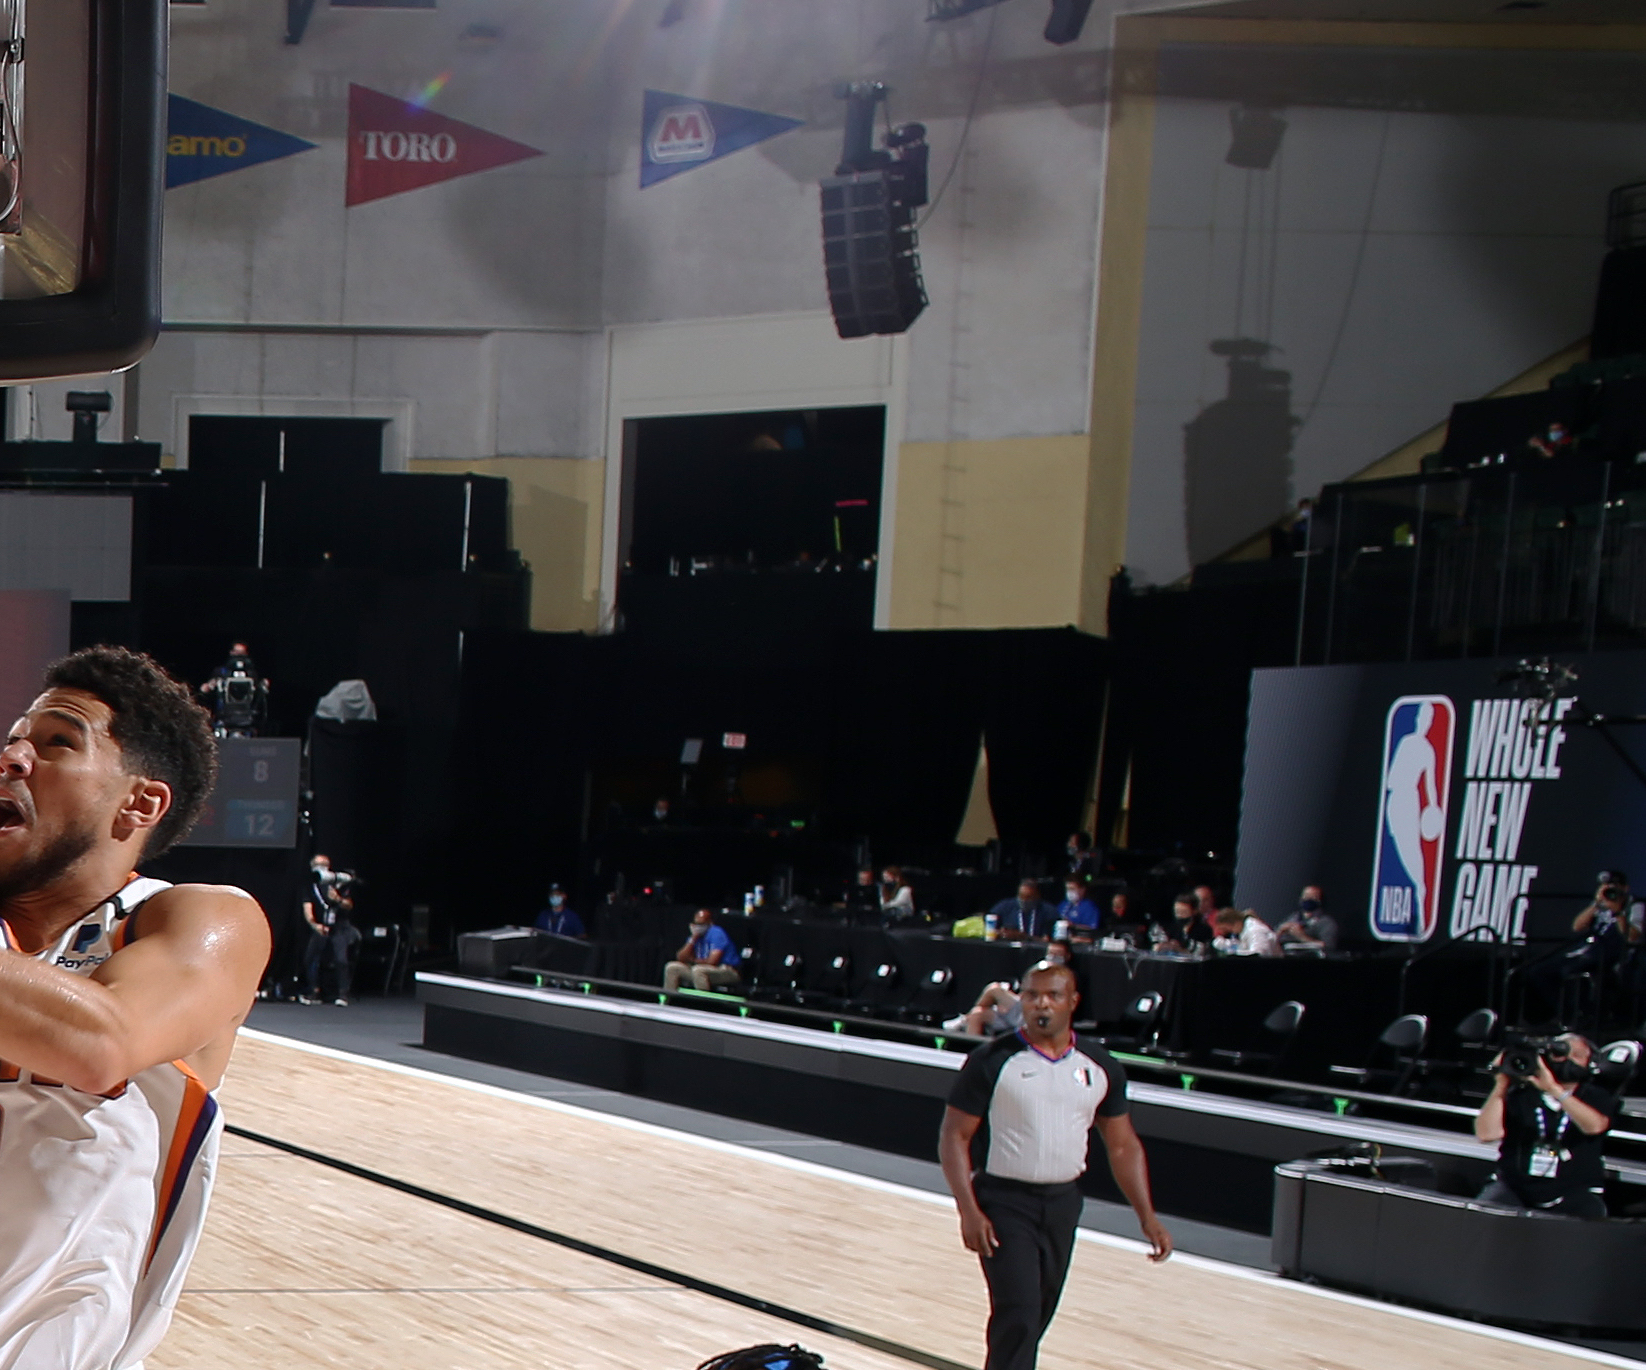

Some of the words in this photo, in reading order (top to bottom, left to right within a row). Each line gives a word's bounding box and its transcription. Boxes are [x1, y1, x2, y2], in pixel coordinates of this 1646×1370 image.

[361, 121, 457, 163] TORO
[1464, 698, 1575, 780] WHOLE
[246, 813, 275, 837] 12
[1455, 780, 1533, 862] NEW
[1380, 884, 1413, 924] NBA
[1450, 863, 1539, 946] GAME
[56, 952, 110, 970] PayPa
